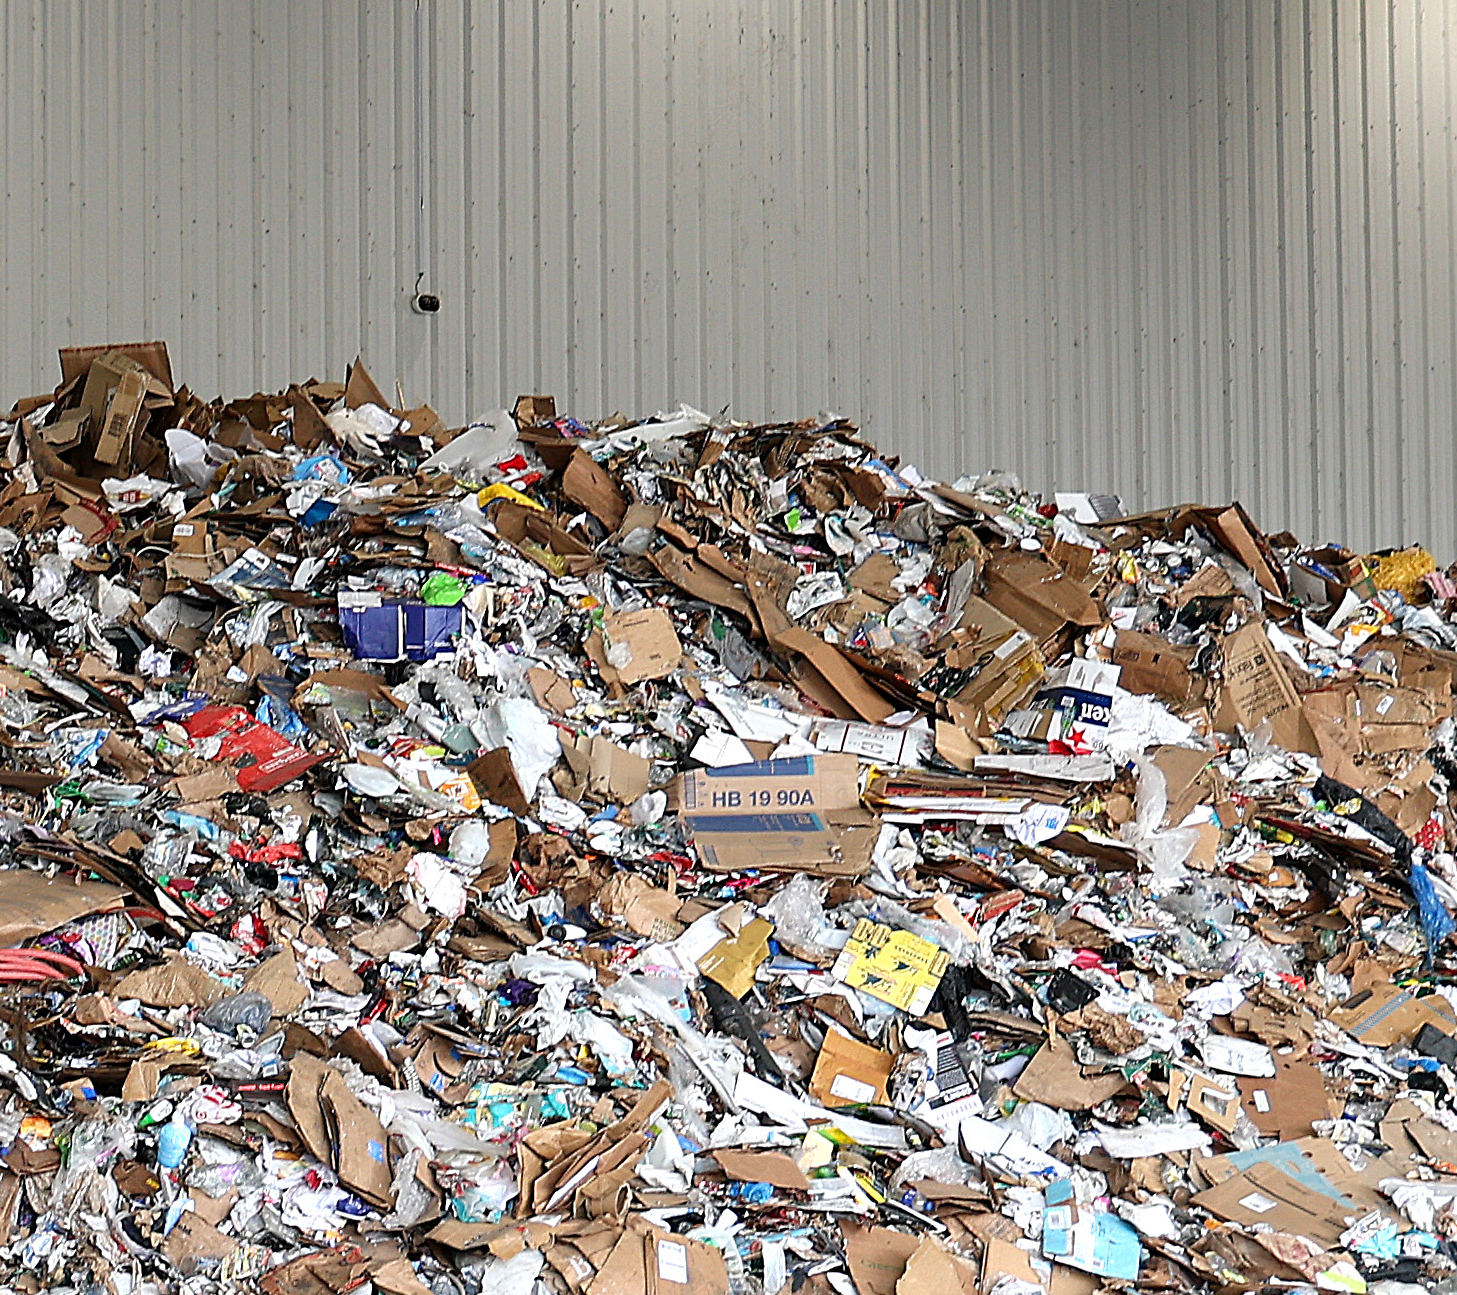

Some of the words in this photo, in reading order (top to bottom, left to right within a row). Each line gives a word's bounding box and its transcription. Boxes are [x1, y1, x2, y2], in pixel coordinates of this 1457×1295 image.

[712, 791, 741, 808] HB
[749, 790, 771, 807] 19
[776, 789, 814, 806] 90A
